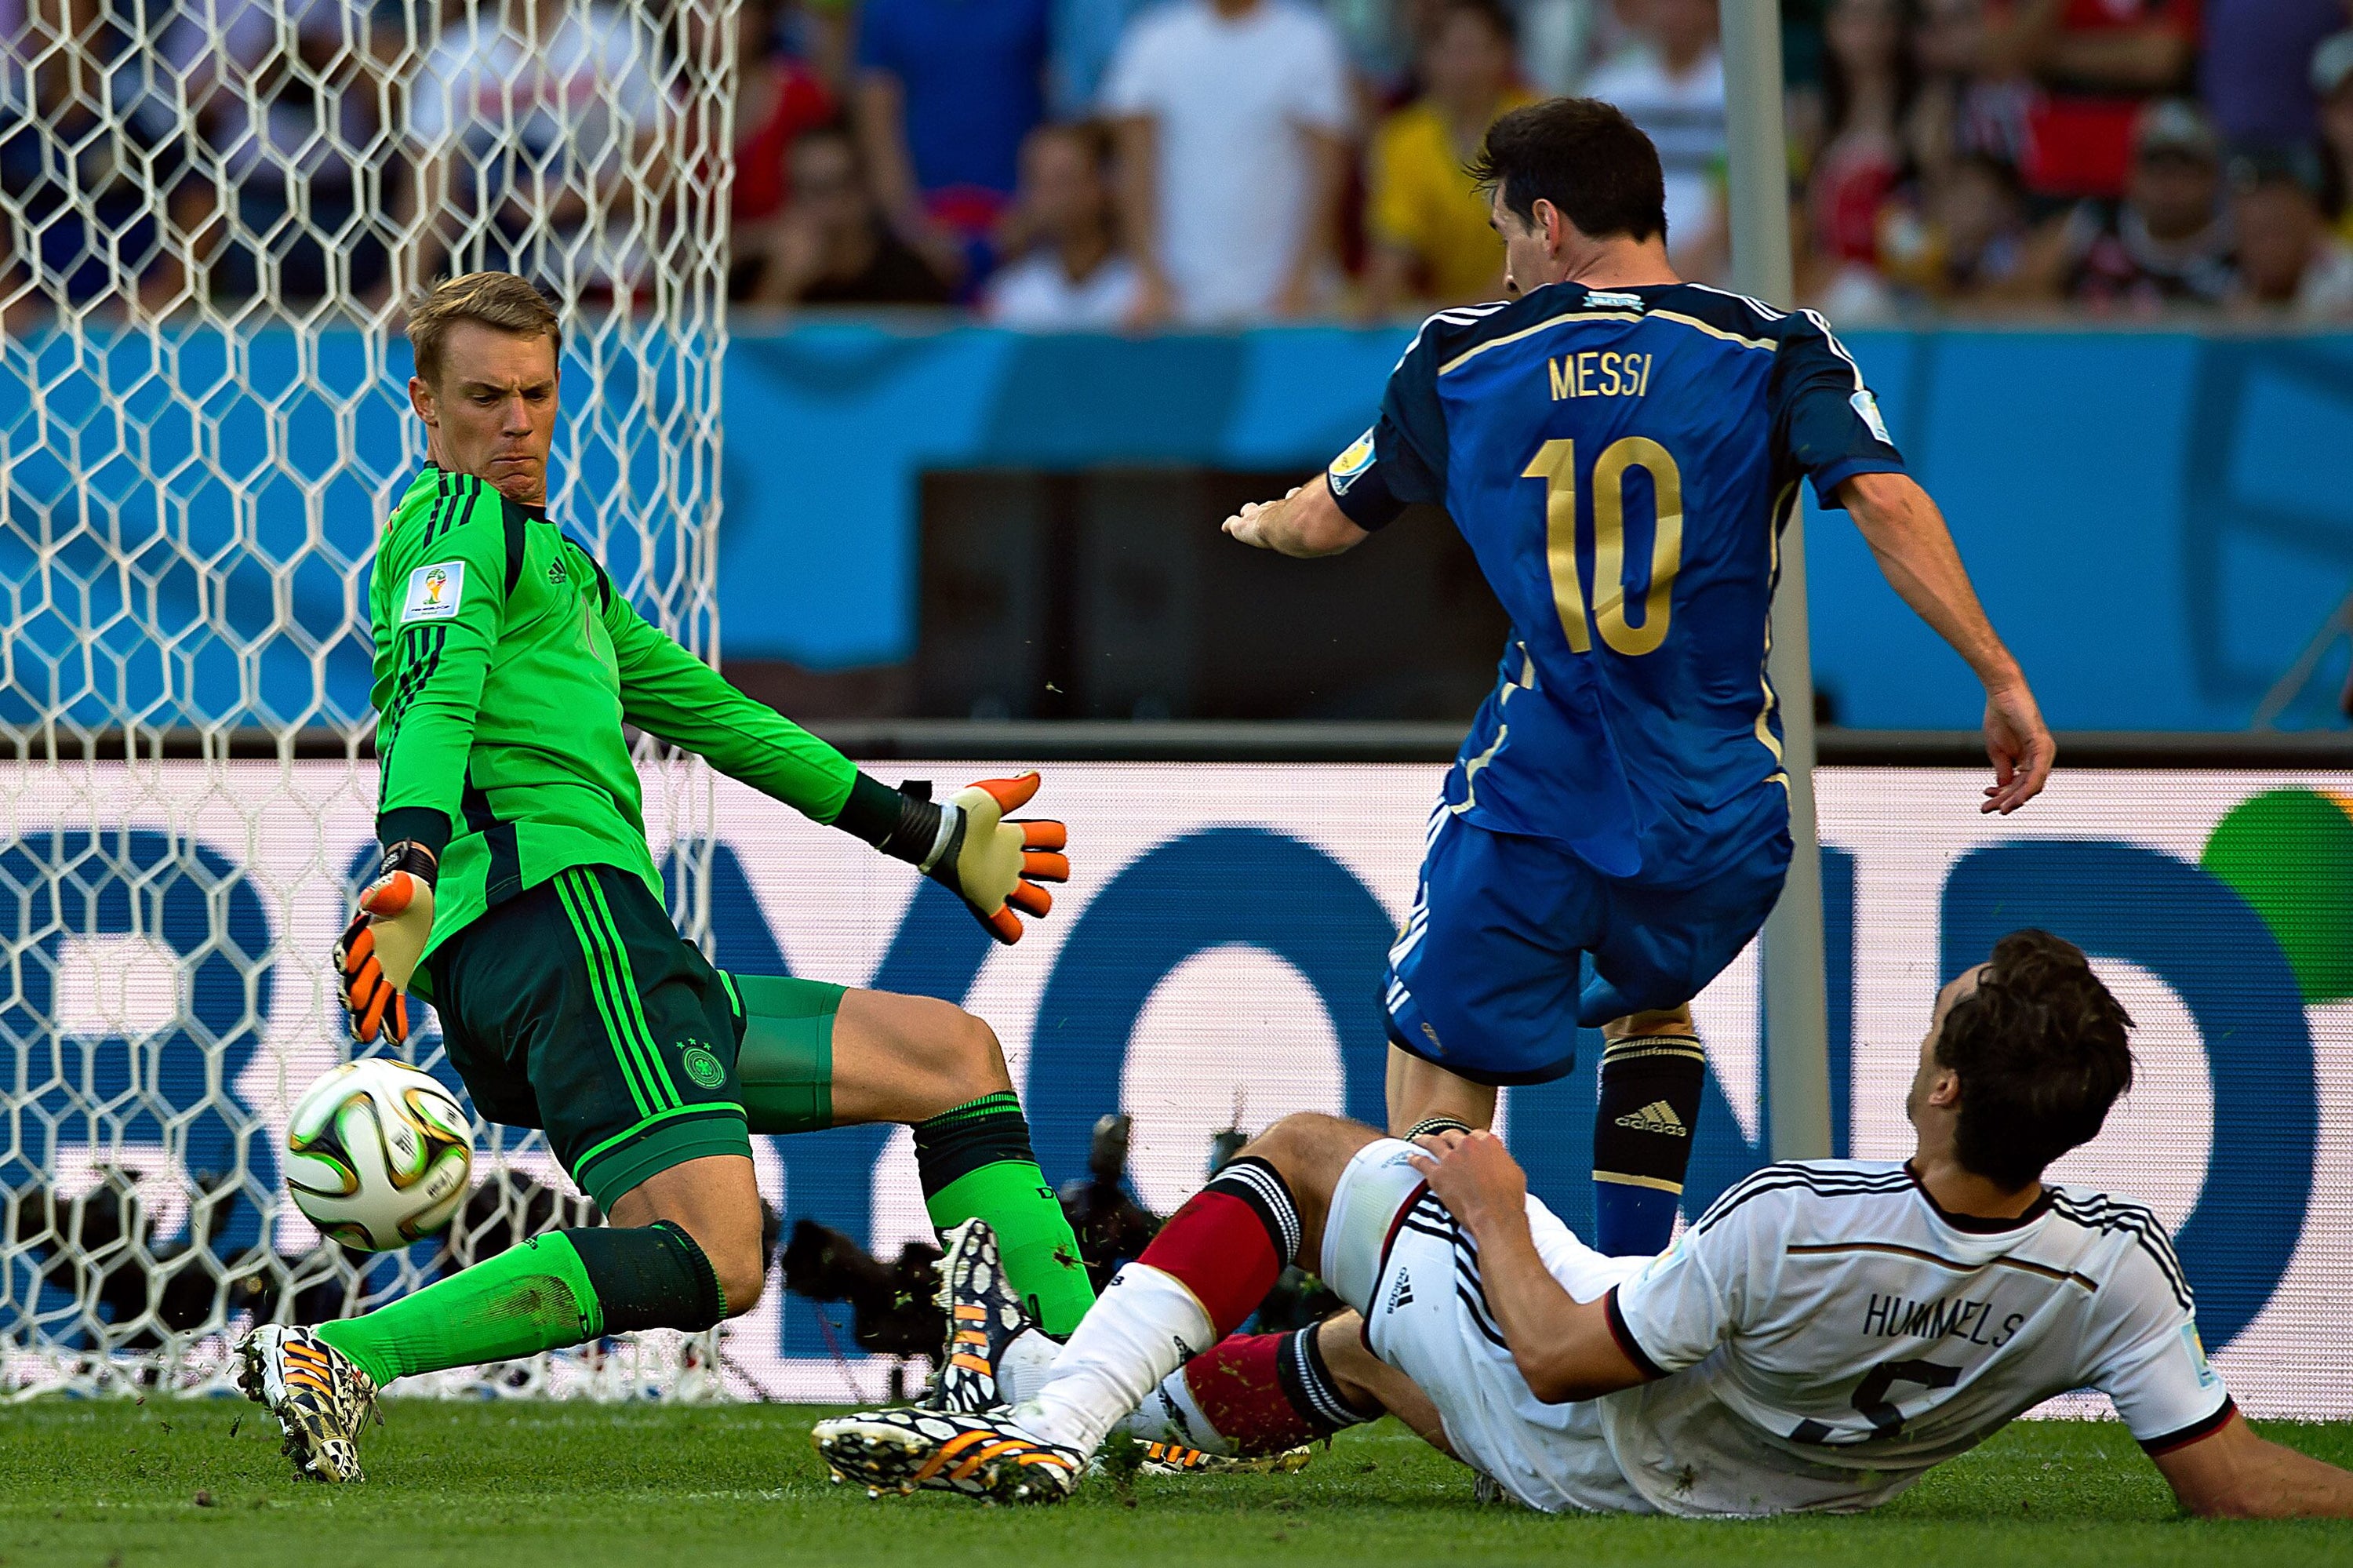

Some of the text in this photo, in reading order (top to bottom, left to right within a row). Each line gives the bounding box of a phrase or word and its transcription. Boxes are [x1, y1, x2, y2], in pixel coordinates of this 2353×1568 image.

[1548, 351, 1653, 401] MESSI
[1522, 436, 1683, 656] 10
[0, 826, 2318, 1359] BYOD
[1615, 1116, 1687, 1137] adidas
[1387, 1266, 1408, 1315] adidas
[1863, 1293, 2024, 1348] HUMMELS
